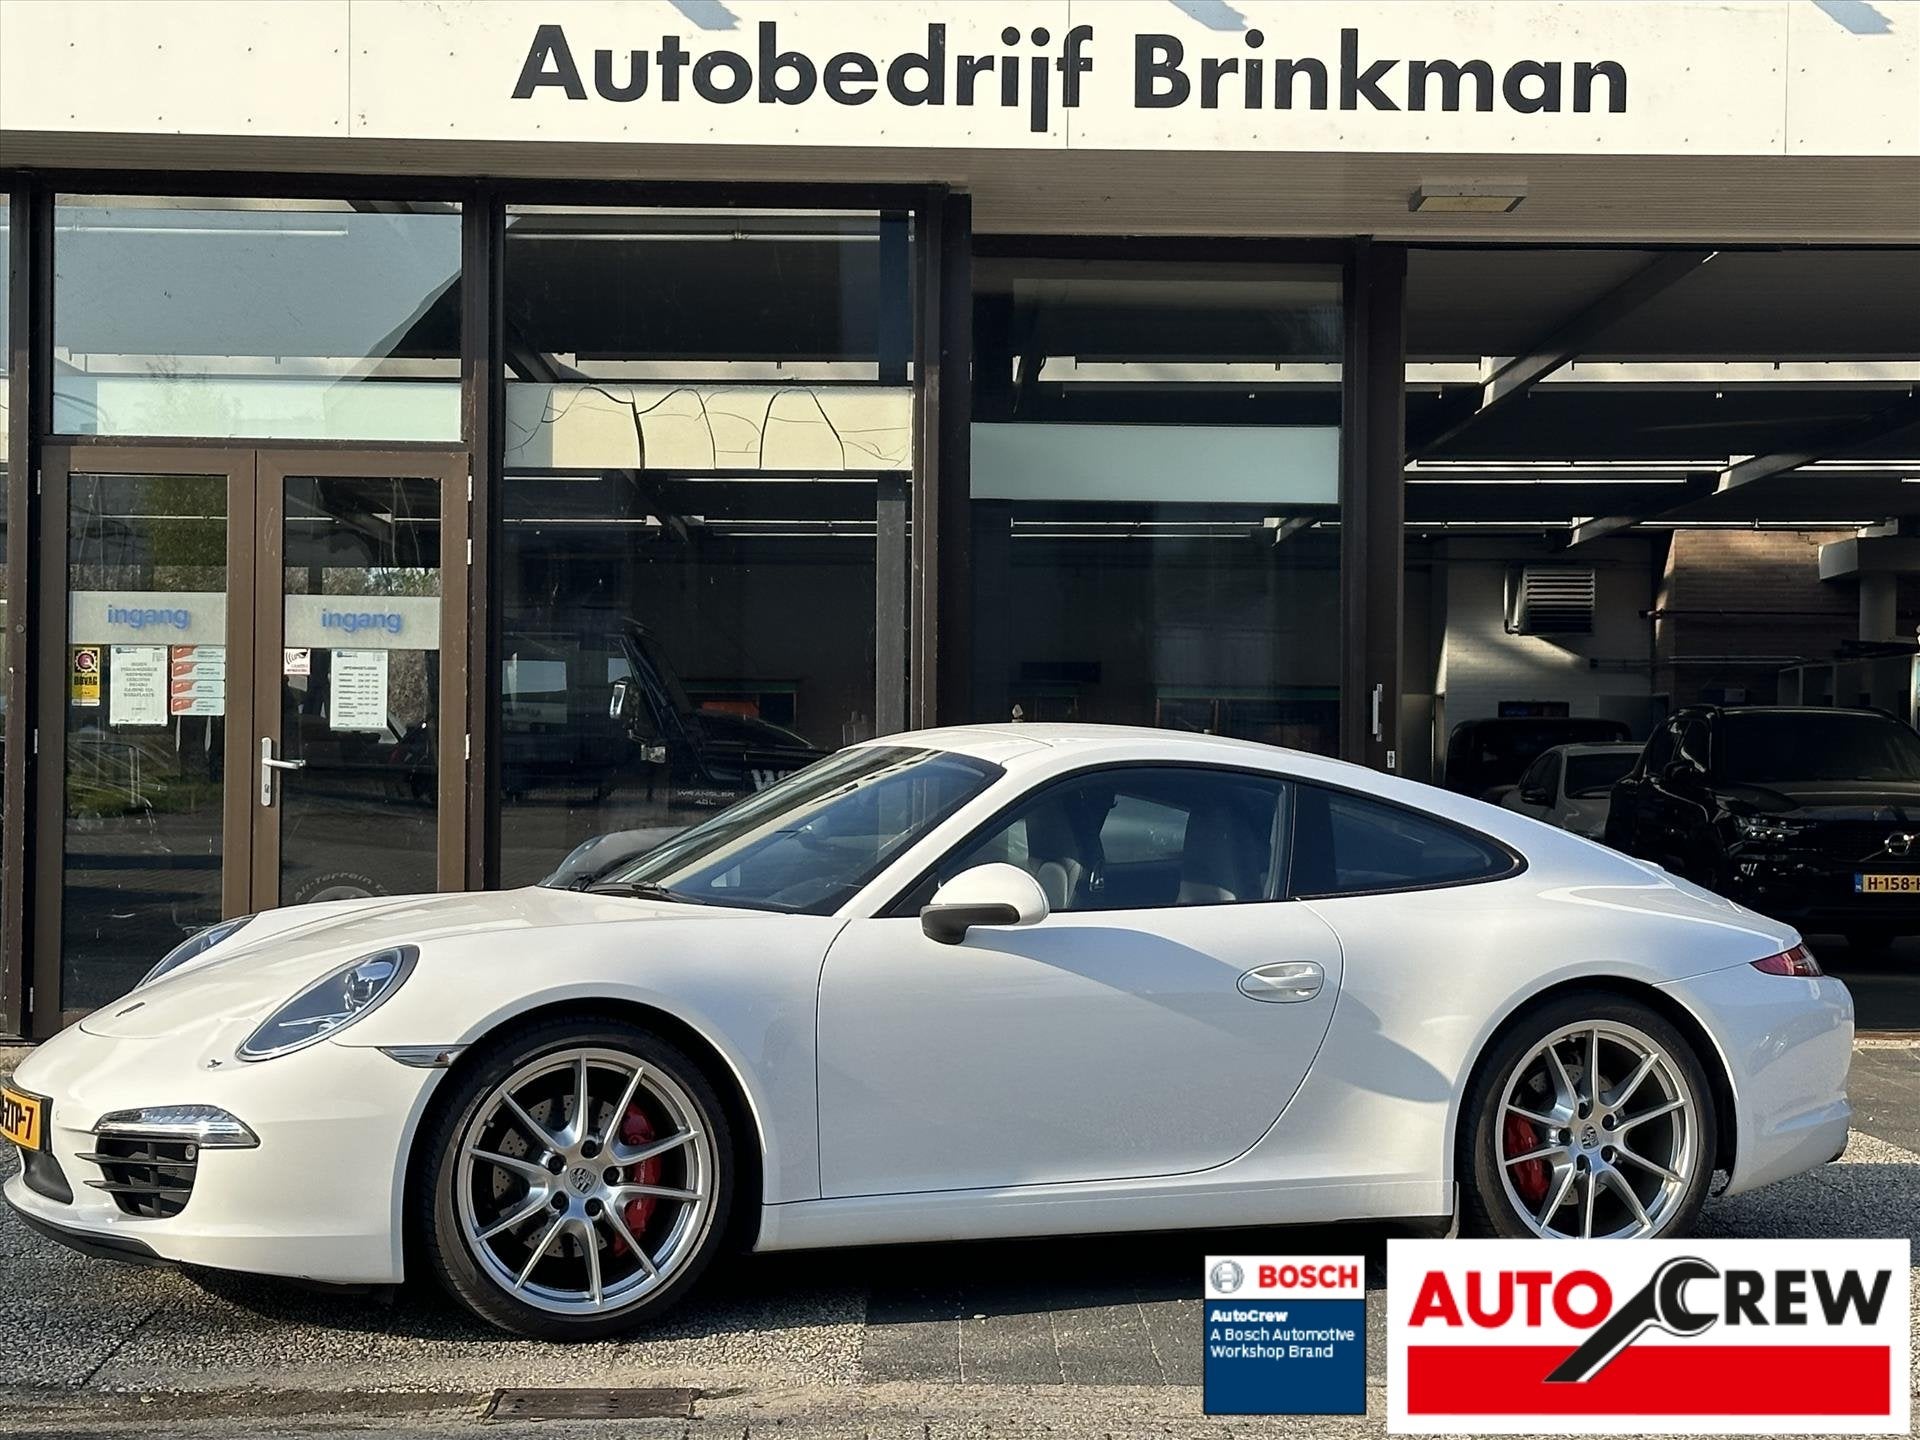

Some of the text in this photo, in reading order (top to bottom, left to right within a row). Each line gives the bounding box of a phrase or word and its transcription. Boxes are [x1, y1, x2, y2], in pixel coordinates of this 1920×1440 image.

[511, 21, 1627, 132] Autobedrijf Brinkman
[107, 604, 190, 630] ingang
[321, 608, 404, 633] ingang
[677, 790, 736, 798] WRANGLER
